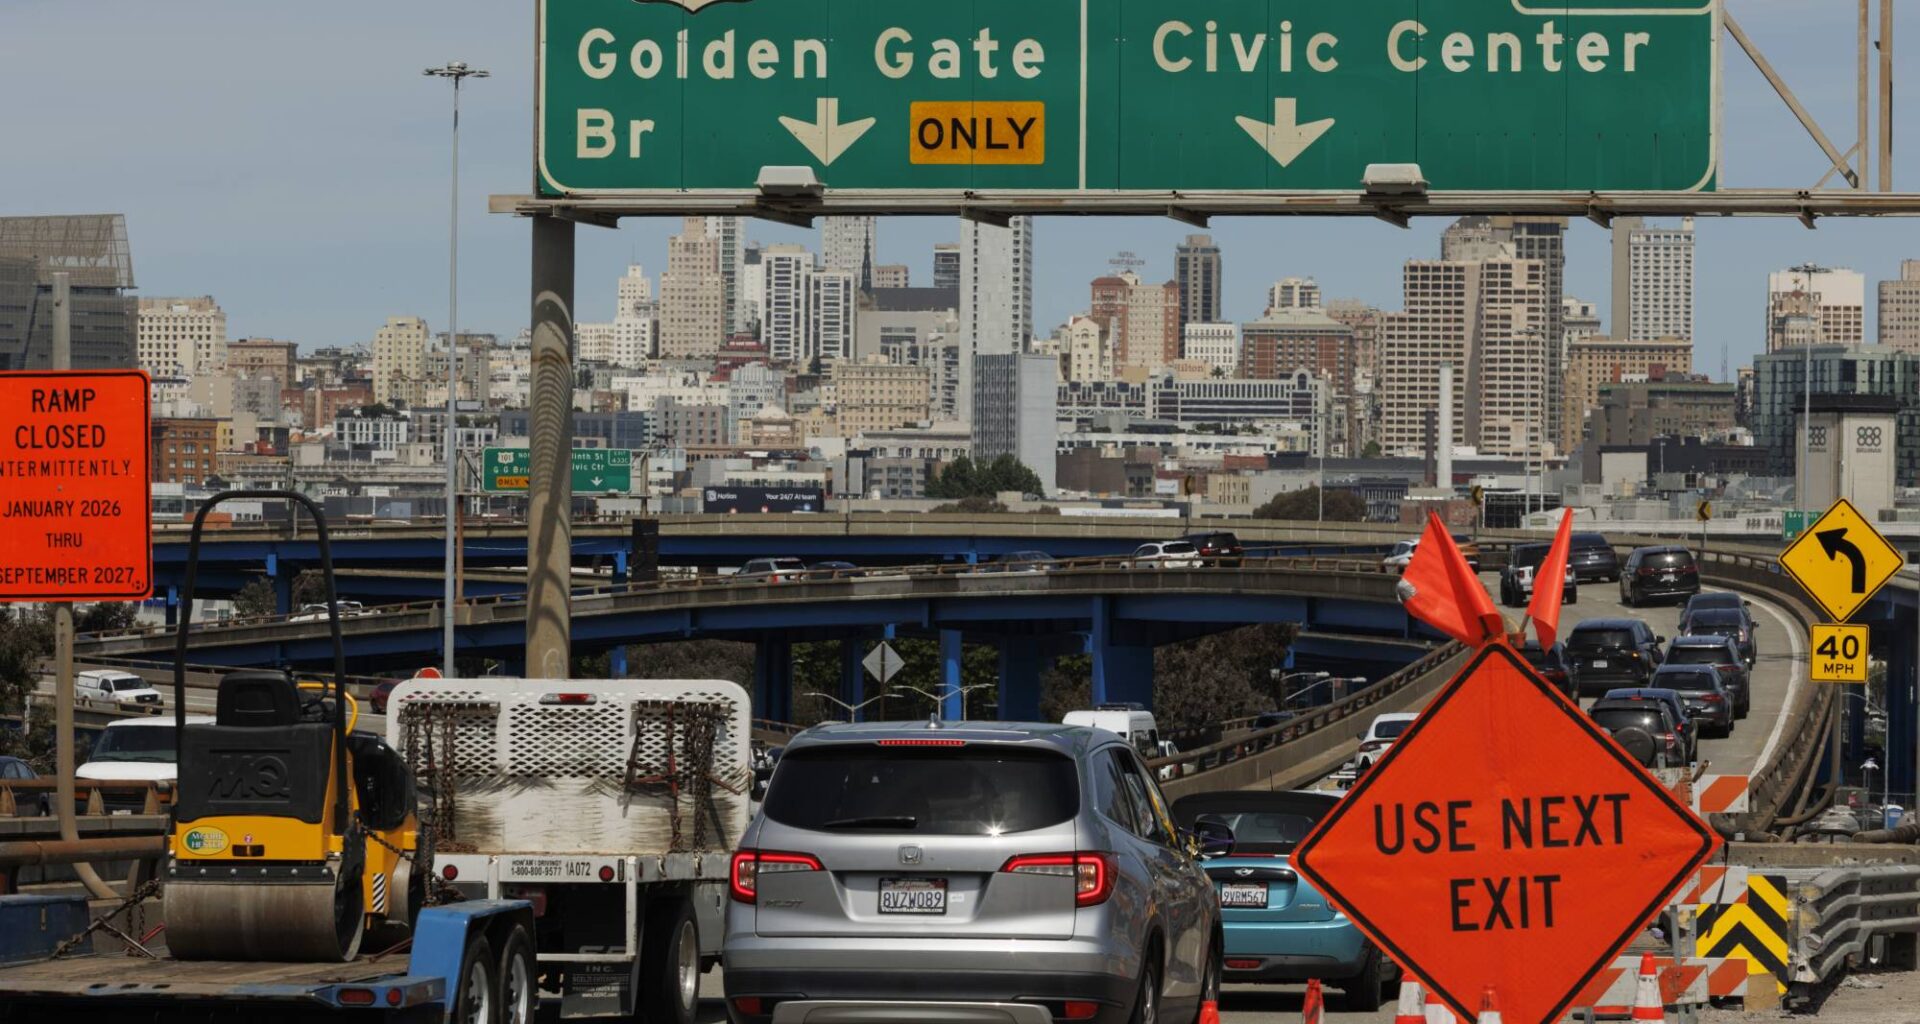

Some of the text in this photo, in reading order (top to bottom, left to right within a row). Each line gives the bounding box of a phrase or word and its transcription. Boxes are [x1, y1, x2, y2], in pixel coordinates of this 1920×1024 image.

[578, 27, 1045, 80] Golden Gate
[1152, 20, 1650, 73] Civic Center
[576, 108, 655, 159] Br
[917, 117, 1037, 150] ONLY
[31, 388, 96, 413] RAMP
[15, 424, 106, 450] CLOSED
[572, 463, 588, 471] ivic
[498, 478, 520, 486] ONLY
[2, 499, 122, 518] JANUARY 2026
[46, 532, 83, 548] THRU
[93, 567, 135, 585] 2027
[1816, 634, 1860, 660] 40
[1823, 663, 1854, 674] MPH
[1374, 793, 1631, 855] USE NEXT
[565, 862, 591, 876] 1A072
[883, 892, 942, 907] 8VZW089
[1223, 891, 1265, 903] 9VRM567
[1449, 874, 1561, 932] EXIT
